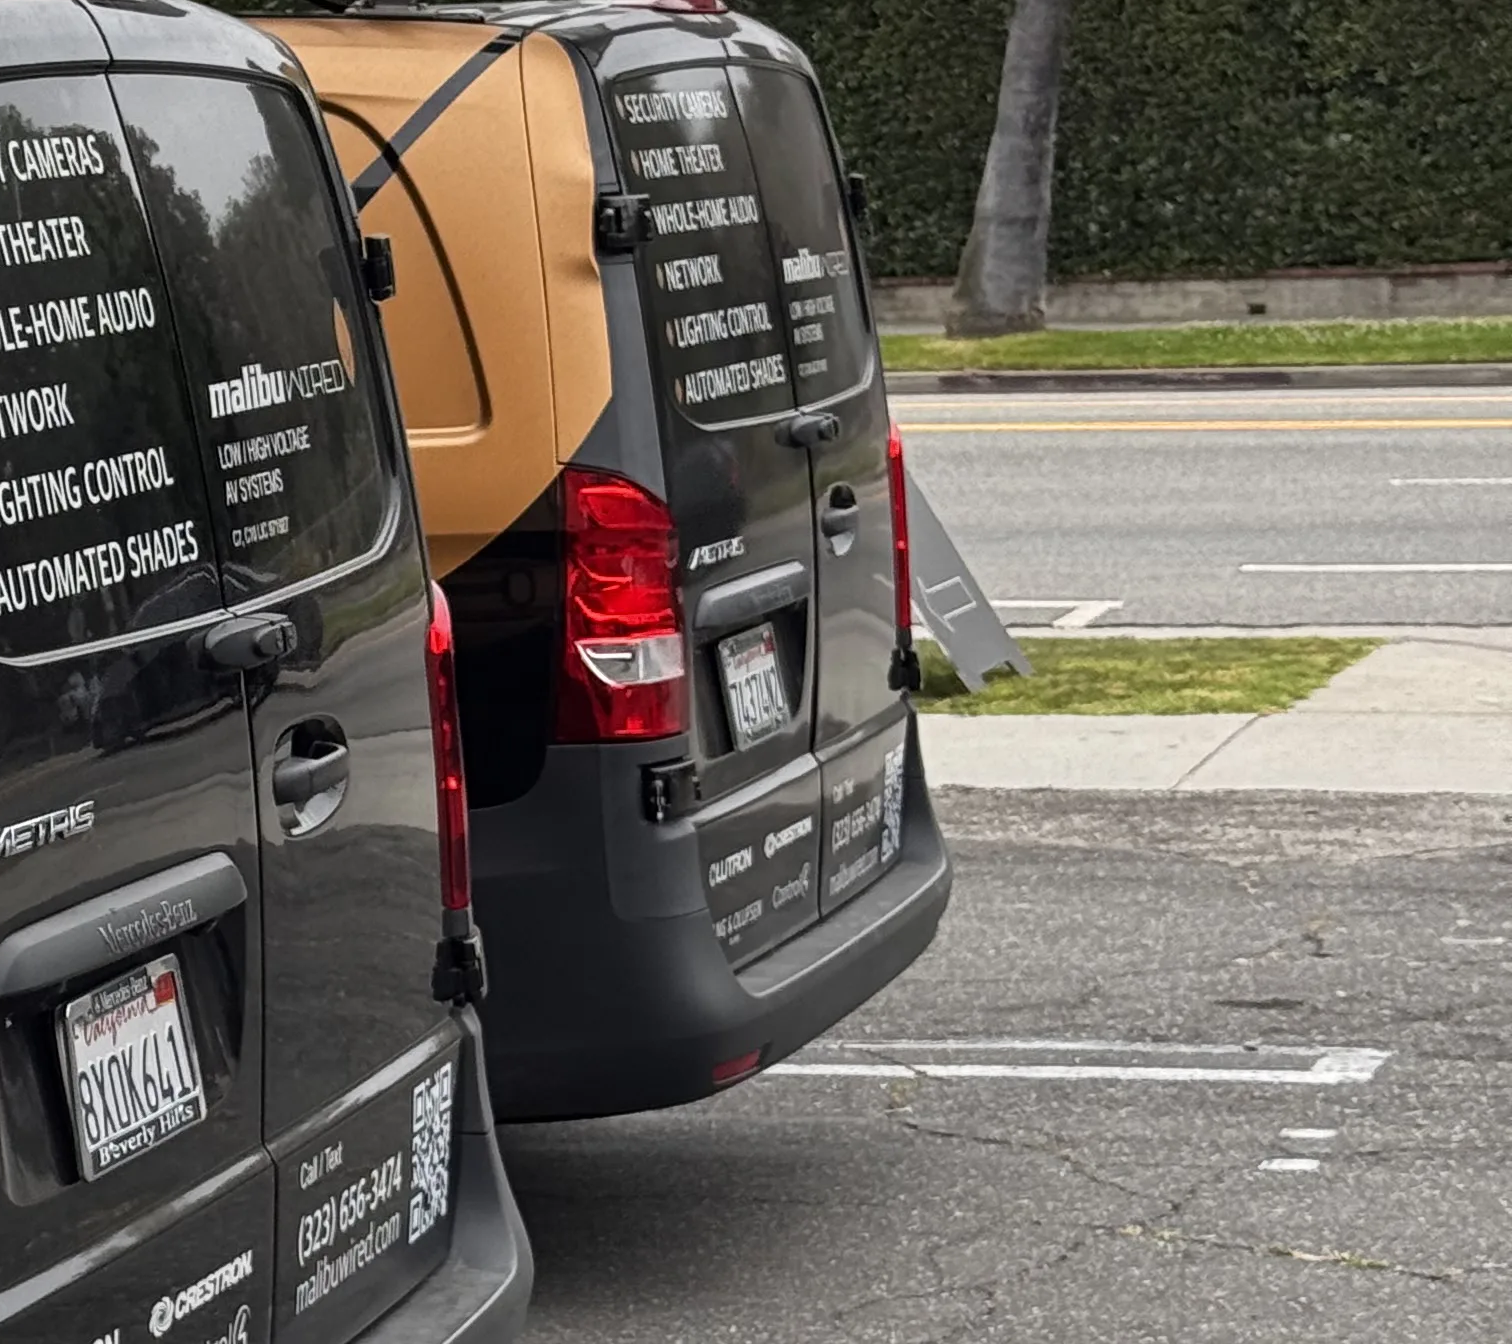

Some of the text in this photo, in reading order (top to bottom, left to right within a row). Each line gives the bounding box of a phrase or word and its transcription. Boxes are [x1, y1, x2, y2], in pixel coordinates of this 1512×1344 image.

[623, 92, 682, 124] SECURITY
[8, 134, 105, 182] CAMERAS
[639, 144, 727, 180] HOME THEATER
[652, 195, 761, 236] WHOLE-HOME AUDIO
[664, 254, 724, 292] NETWORK
[96, 287, 156, 336] AUDIO
[674, 308, 729, 349] LIGHTING
[727, 302, 774, 335] CONTROL
[684, 363, 750, 404] AUTOMATED
[750, 354, 787, 388] SHADES
[217, 441, 242, 470] LOW
[247, 434, 273, 463] HIGH
[271, 425, 312, 456] VOLTAGE
[83, 447, 174, 501] CONTROL
[225, 468, 284, 507] AV SYSTEMS
[128, 520, 199, 577] SHADES
[98, 1104, 195, 1167] Beverly Hills
[300, 1155, 318, 1190] Call
[324, 1141, 344, 1173] Text
[298, 1151, 403, 1268] (323) 656-3474
[174, 1250, 253, 1320] CRESTRON
[295, 1212, 401, 1315] malibuwired.com
